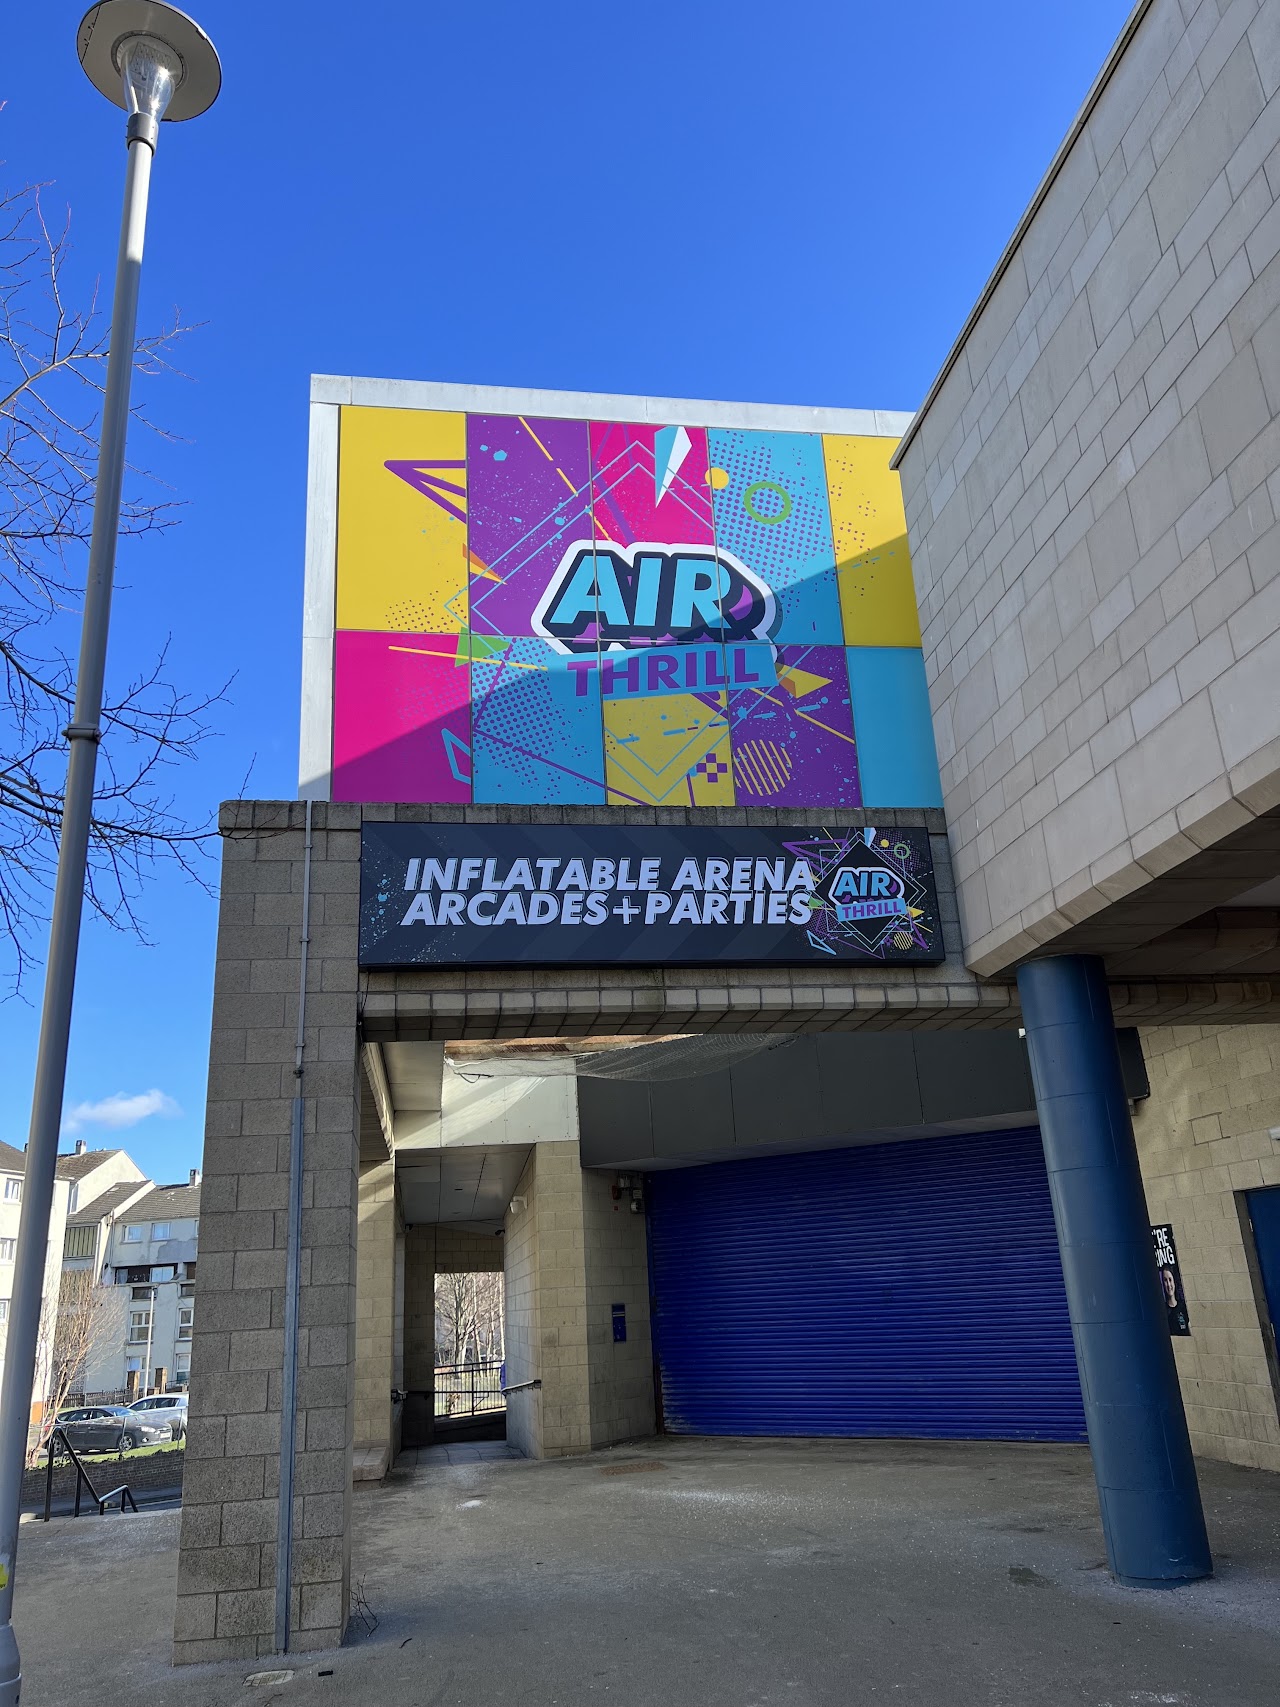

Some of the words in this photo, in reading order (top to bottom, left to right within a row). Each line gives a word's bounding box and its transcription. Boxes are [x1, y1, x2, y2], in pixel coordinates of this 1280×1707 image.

[549, 554, 732, 629] AIR
[566, 647, 760, 697] THRILL
[403, 857, 662, 891] INFLATABLE
[671, 857, 816, 891] ARENA
[833, 871, 892, 897] AIR
[841, 901, 902, 919] THRILL
[1152, 1228, 1169, 1248] 'RE
